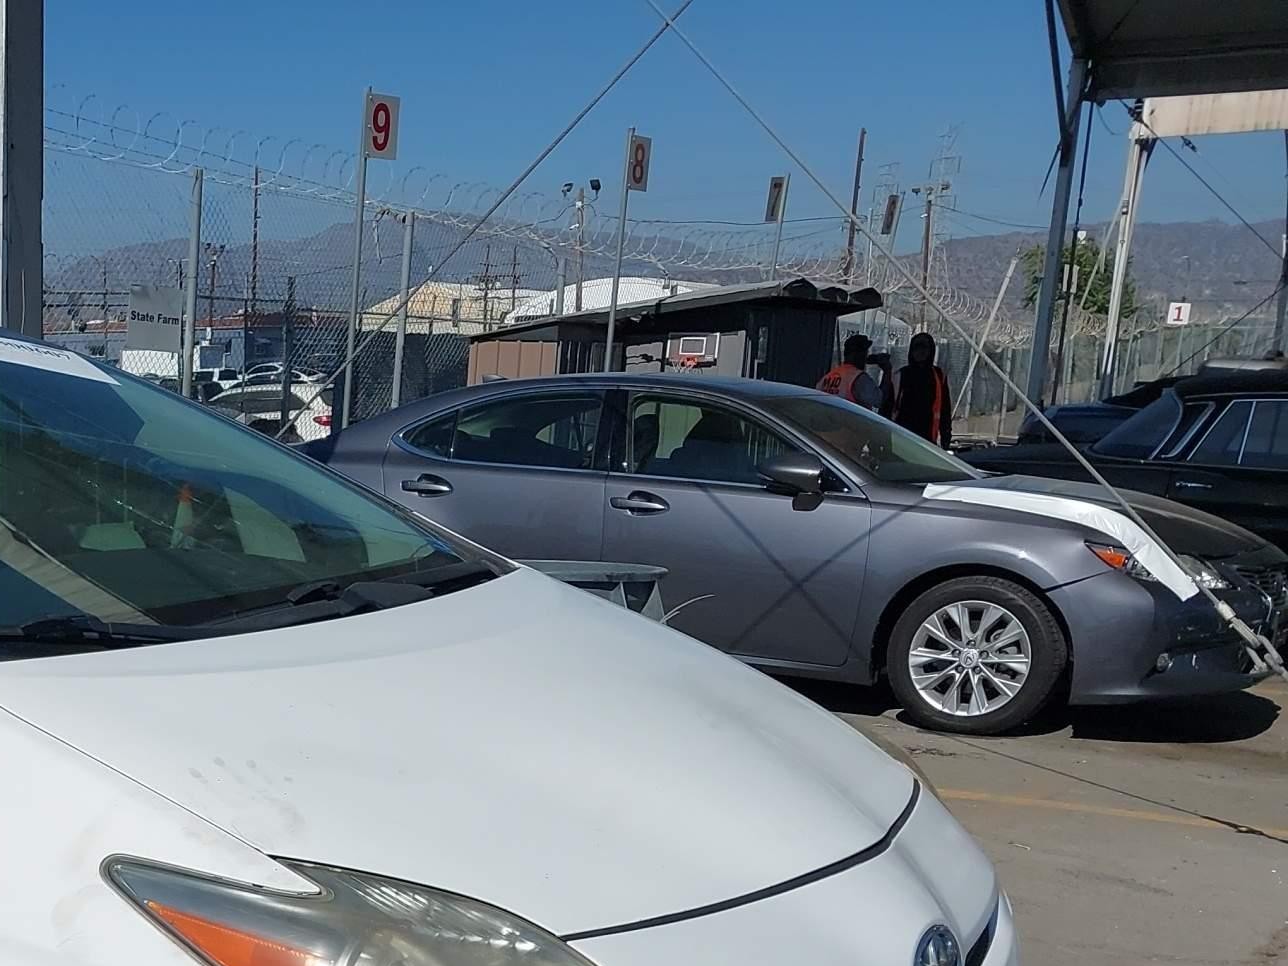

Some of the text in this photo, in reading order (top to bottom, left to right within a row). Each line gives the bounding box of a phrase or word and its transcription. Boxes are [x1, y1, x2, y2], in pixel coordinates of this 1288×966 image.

[372, 102, 391, 152] 9
[632, 143, 645, 185] 8
[770, 182, 783, 217] 7
[130, 310, 180, 325] State Farm
[1172, 305, 1184, 322] 1
